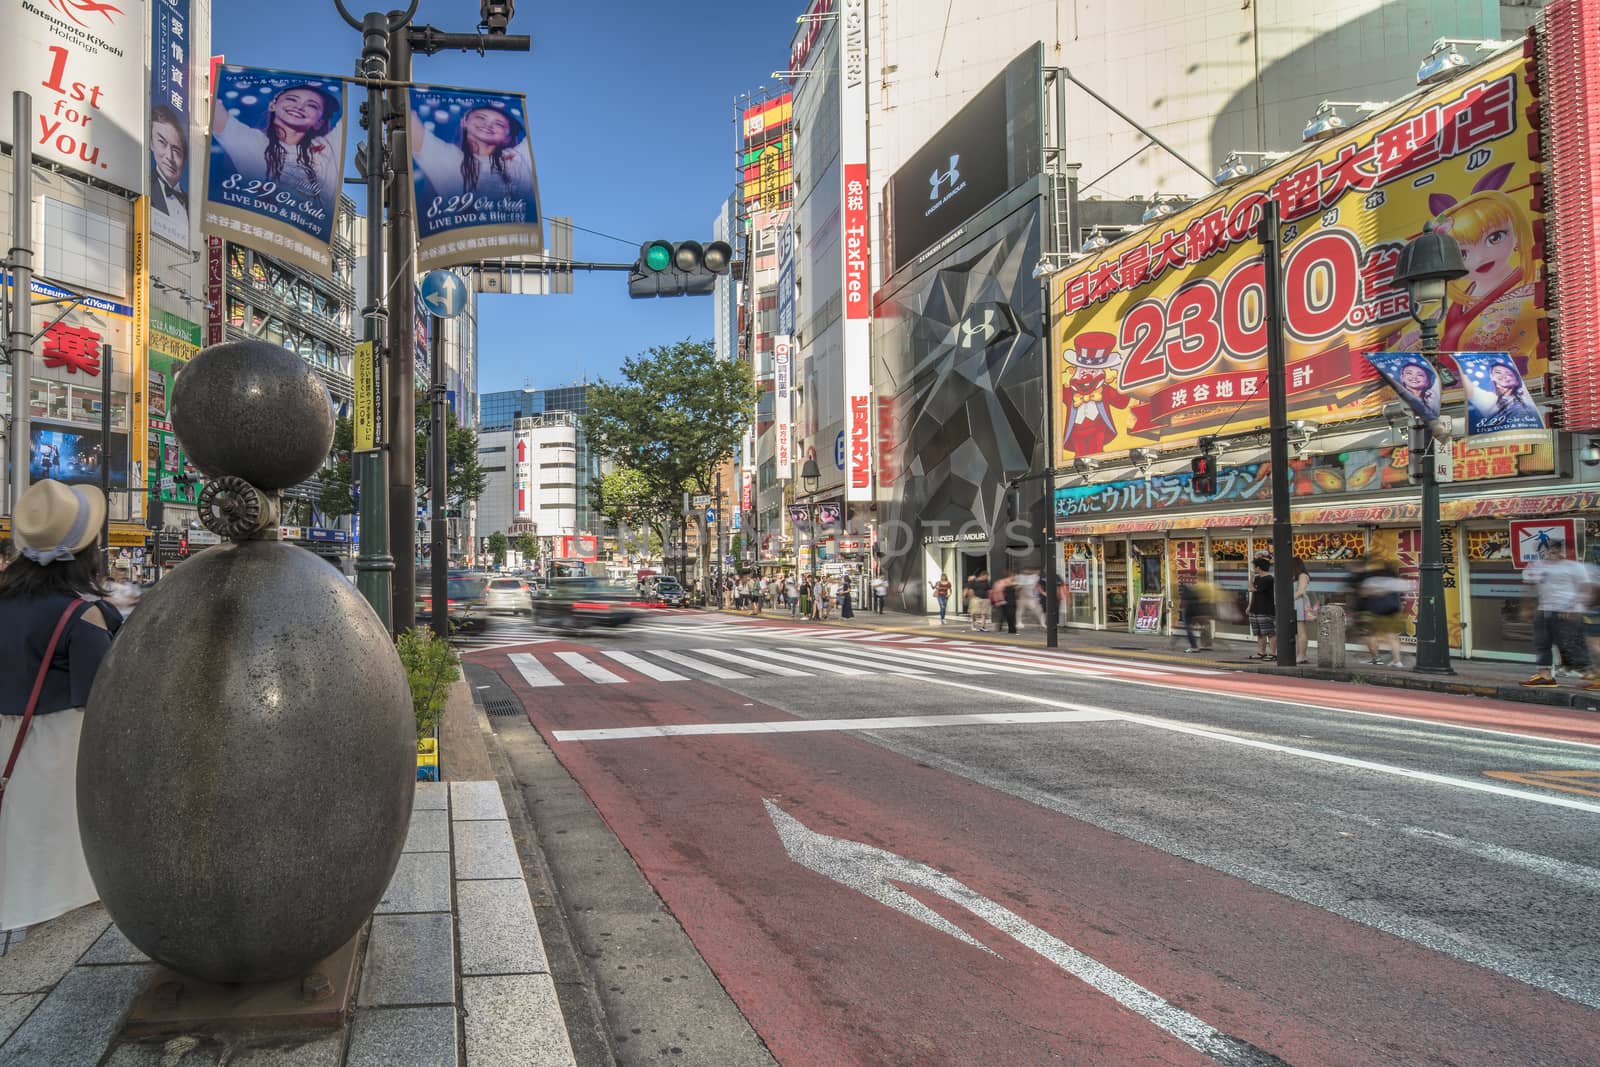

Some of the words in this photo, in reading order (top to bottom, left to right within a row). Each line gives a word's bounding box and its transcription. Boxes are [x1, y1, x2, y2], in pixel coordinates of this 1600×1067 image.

[22, 1, 85, 38] Matsumoto
[87, 33, 124, 57] KiYoshi
[49, 25, 98, 54] Holdings
[847, 12, 861, 89] CAMERA
[41, 45, 103, 110] 1st
[171, 17, 184, 112] 愛情資産
[54, 99, 92, 127] for
[222, 173, 277, 198] 8.29
[275, 191, 297, 207] On
[299, 200, 326, 220] Sale
[223, 191, 251, 205] LIVE
[253, 199, 279, 215] DVD
[279, 208, 289, 218] &
[290, 211, 323, 234] Blu-ray
[427, 192, 474, 218] 8.29
[473, 199, 495, 211] On
[925, 200, 943, 217] UNDER
[942, 181, 967, 205] ARMOUR
[1065, 72, 1518, 315] 日本最大級の超大型店
[429, 217, 452, 230] LIVE
[454, 213, 476, 223] DVD
[478, 213, 486, 222] &
[83, 297, 115, 312] KiYoshi
[1348, 293, 1411, 325] OVER
[42, 320, 101, 377] 薬
[1171, 364, 1314, 409] 渋谷地区計
[851, 395, 869, 488] ビックカメラ
[932, 534, 954, 543] UNDER
[954, 532, 986, 542] ARMOUR
